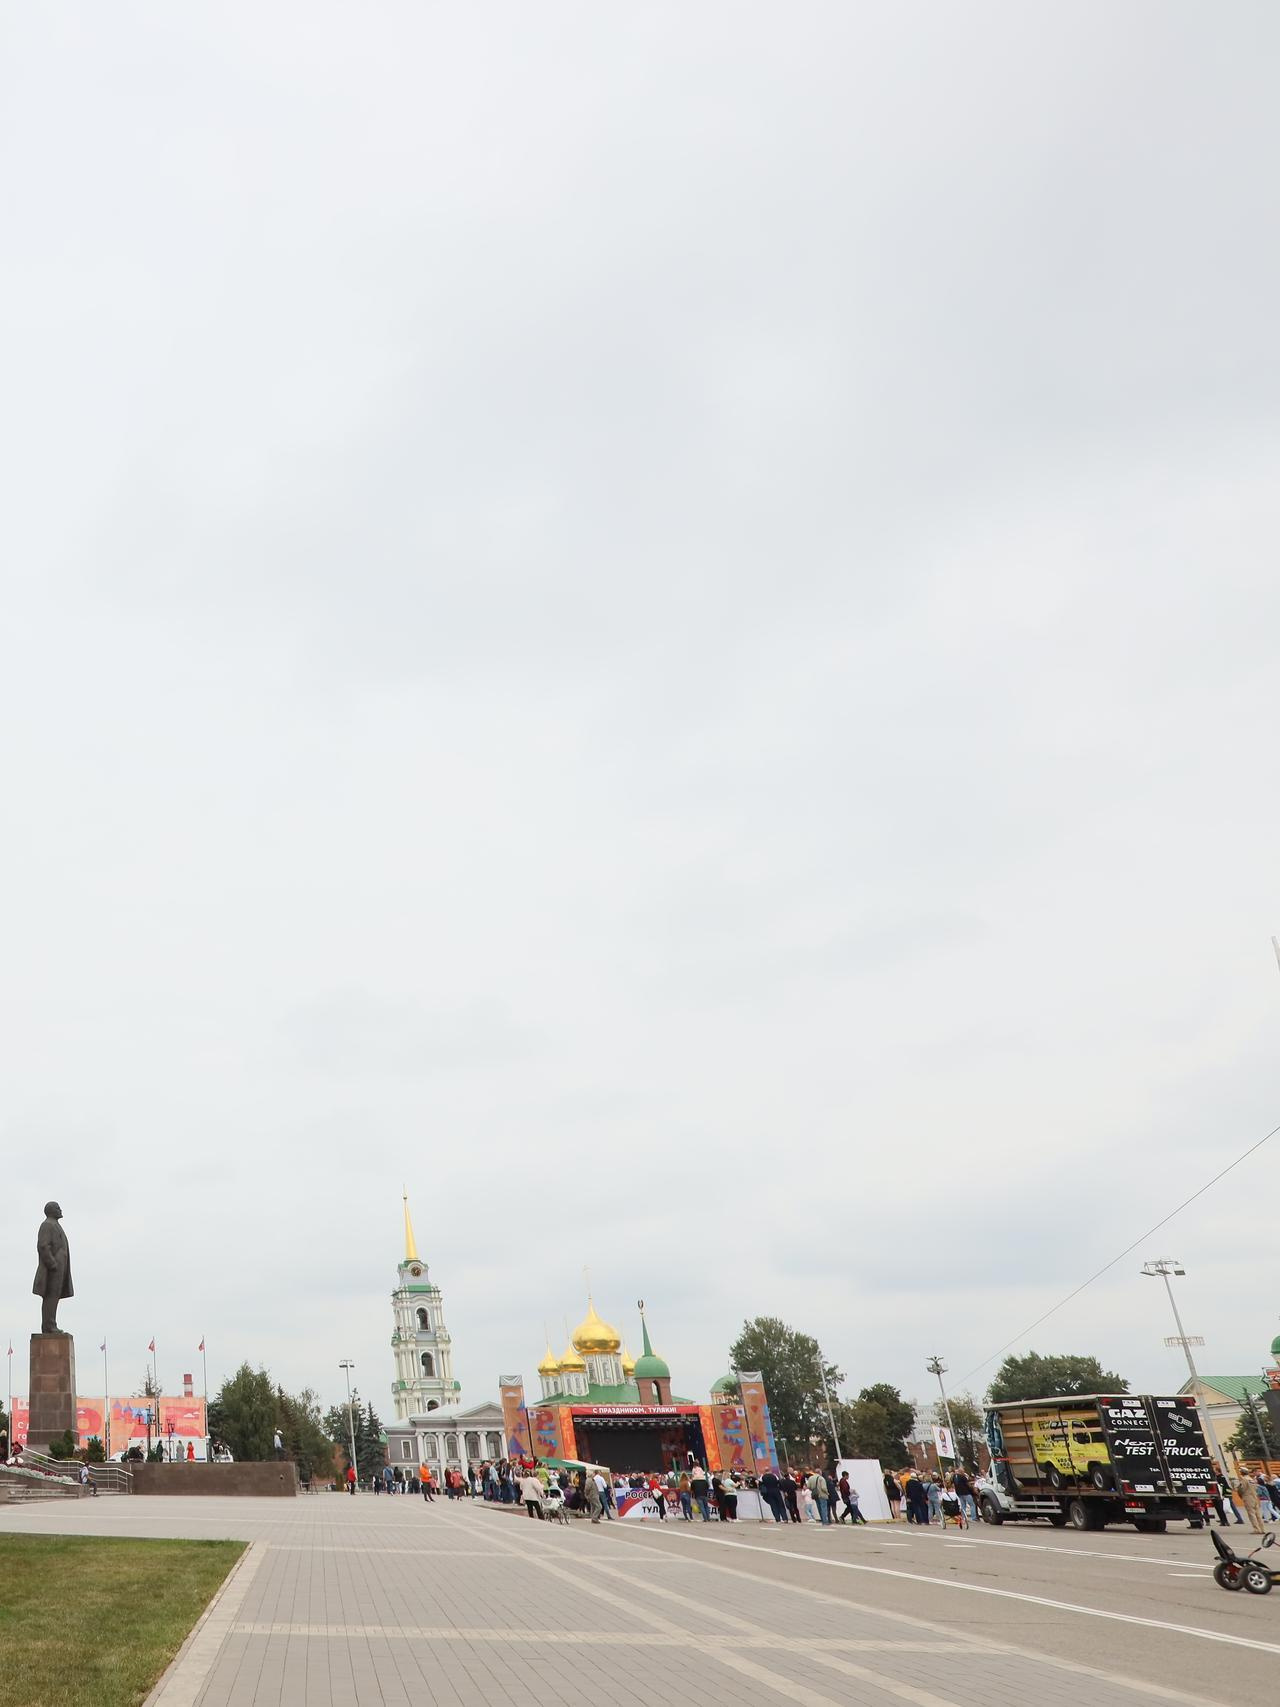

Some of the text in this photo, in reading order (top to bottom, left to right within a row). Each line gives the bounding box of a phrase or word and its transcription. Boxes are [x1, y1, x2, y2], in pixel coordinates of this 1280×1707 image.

[1108, 1408, 1147, 1418] GAZ
[1125, 1446, 1155, 1455] TEST
[625, 1491, 654, 1499] РОССИ
[642, 1505, 660, 1514] ТУЛ
